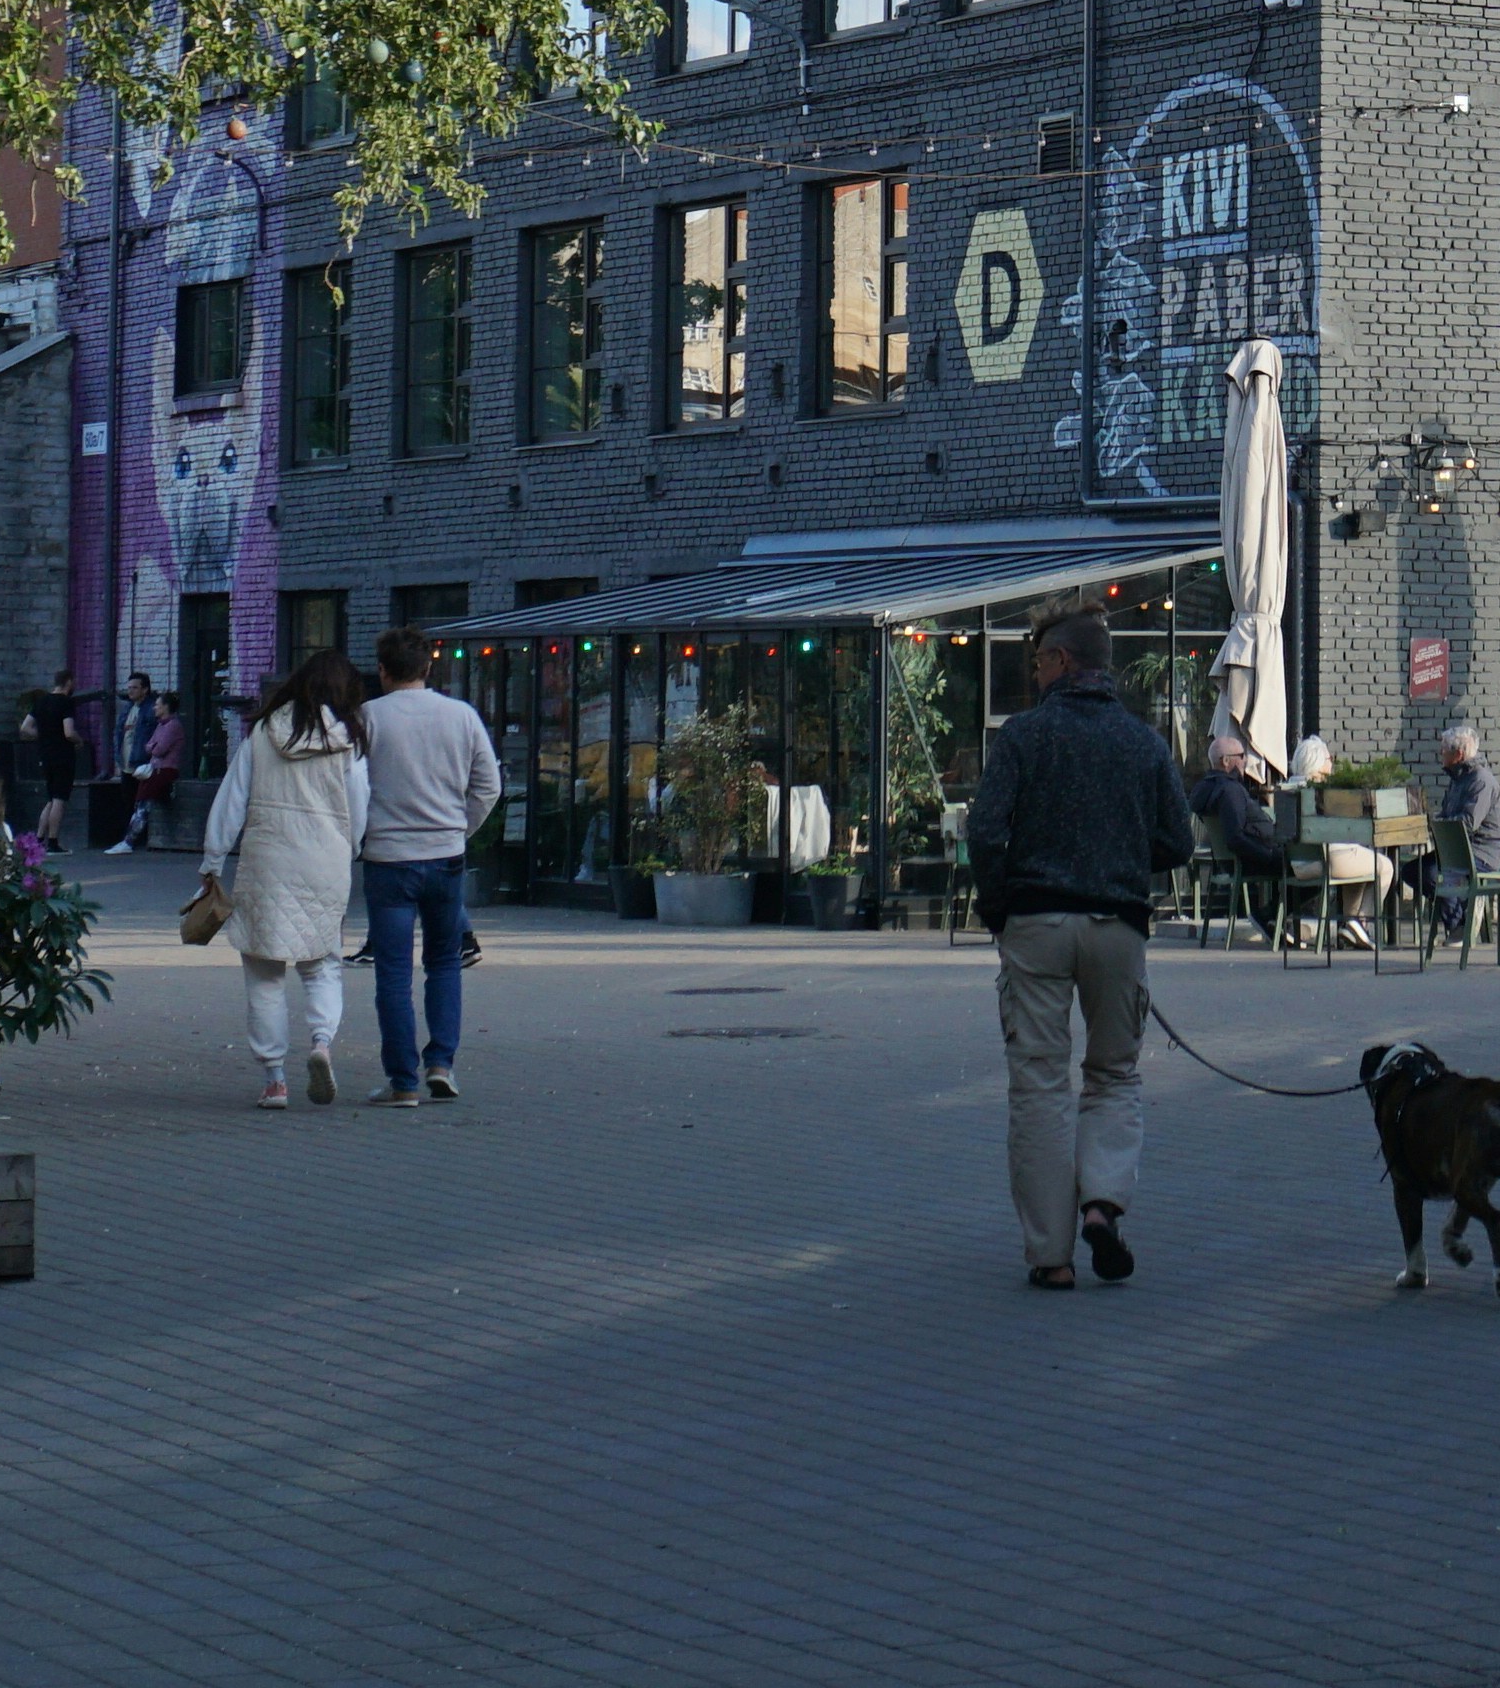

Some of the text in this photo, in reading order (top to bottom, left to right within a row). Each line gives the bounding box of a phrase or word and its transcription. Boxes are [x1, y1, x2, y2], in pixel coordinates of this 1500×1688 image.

[1161, 142, 1248, 239] KIVI
[981, 250, 1021, 345] D
[1161, 252, 1310, 346] PABER
